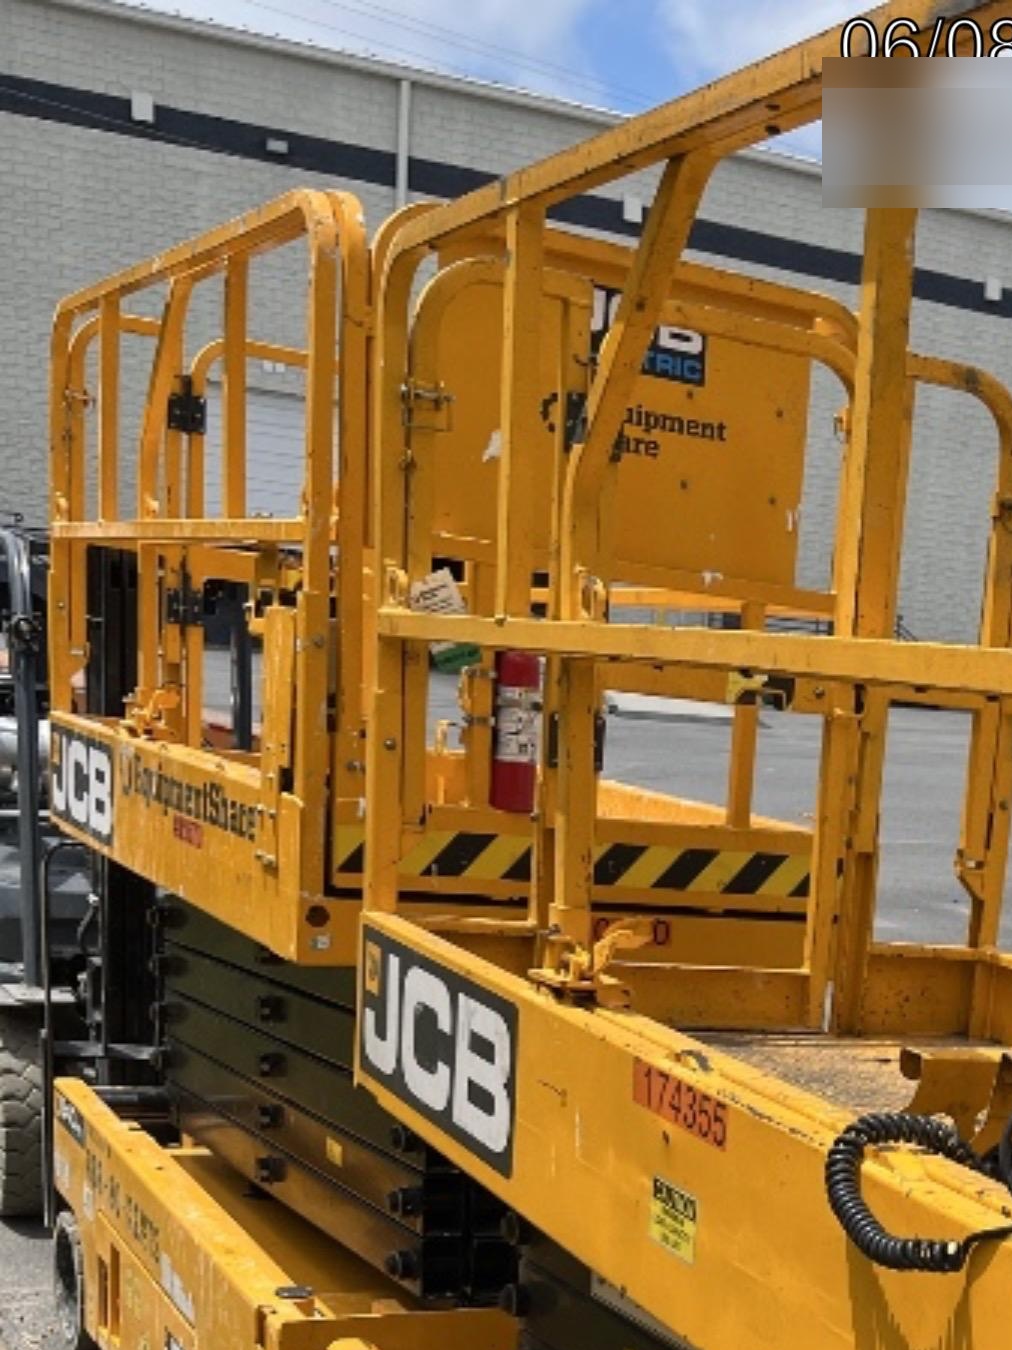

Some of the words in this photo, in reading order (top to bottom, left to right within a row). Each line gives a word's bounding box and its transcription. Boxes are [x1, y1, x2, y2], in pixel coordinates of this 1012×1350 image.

[52, 730, 112, 836] JCB
[364, 953, 512, 1153] JCB
[644, 1067, 728, 1148] 174355
